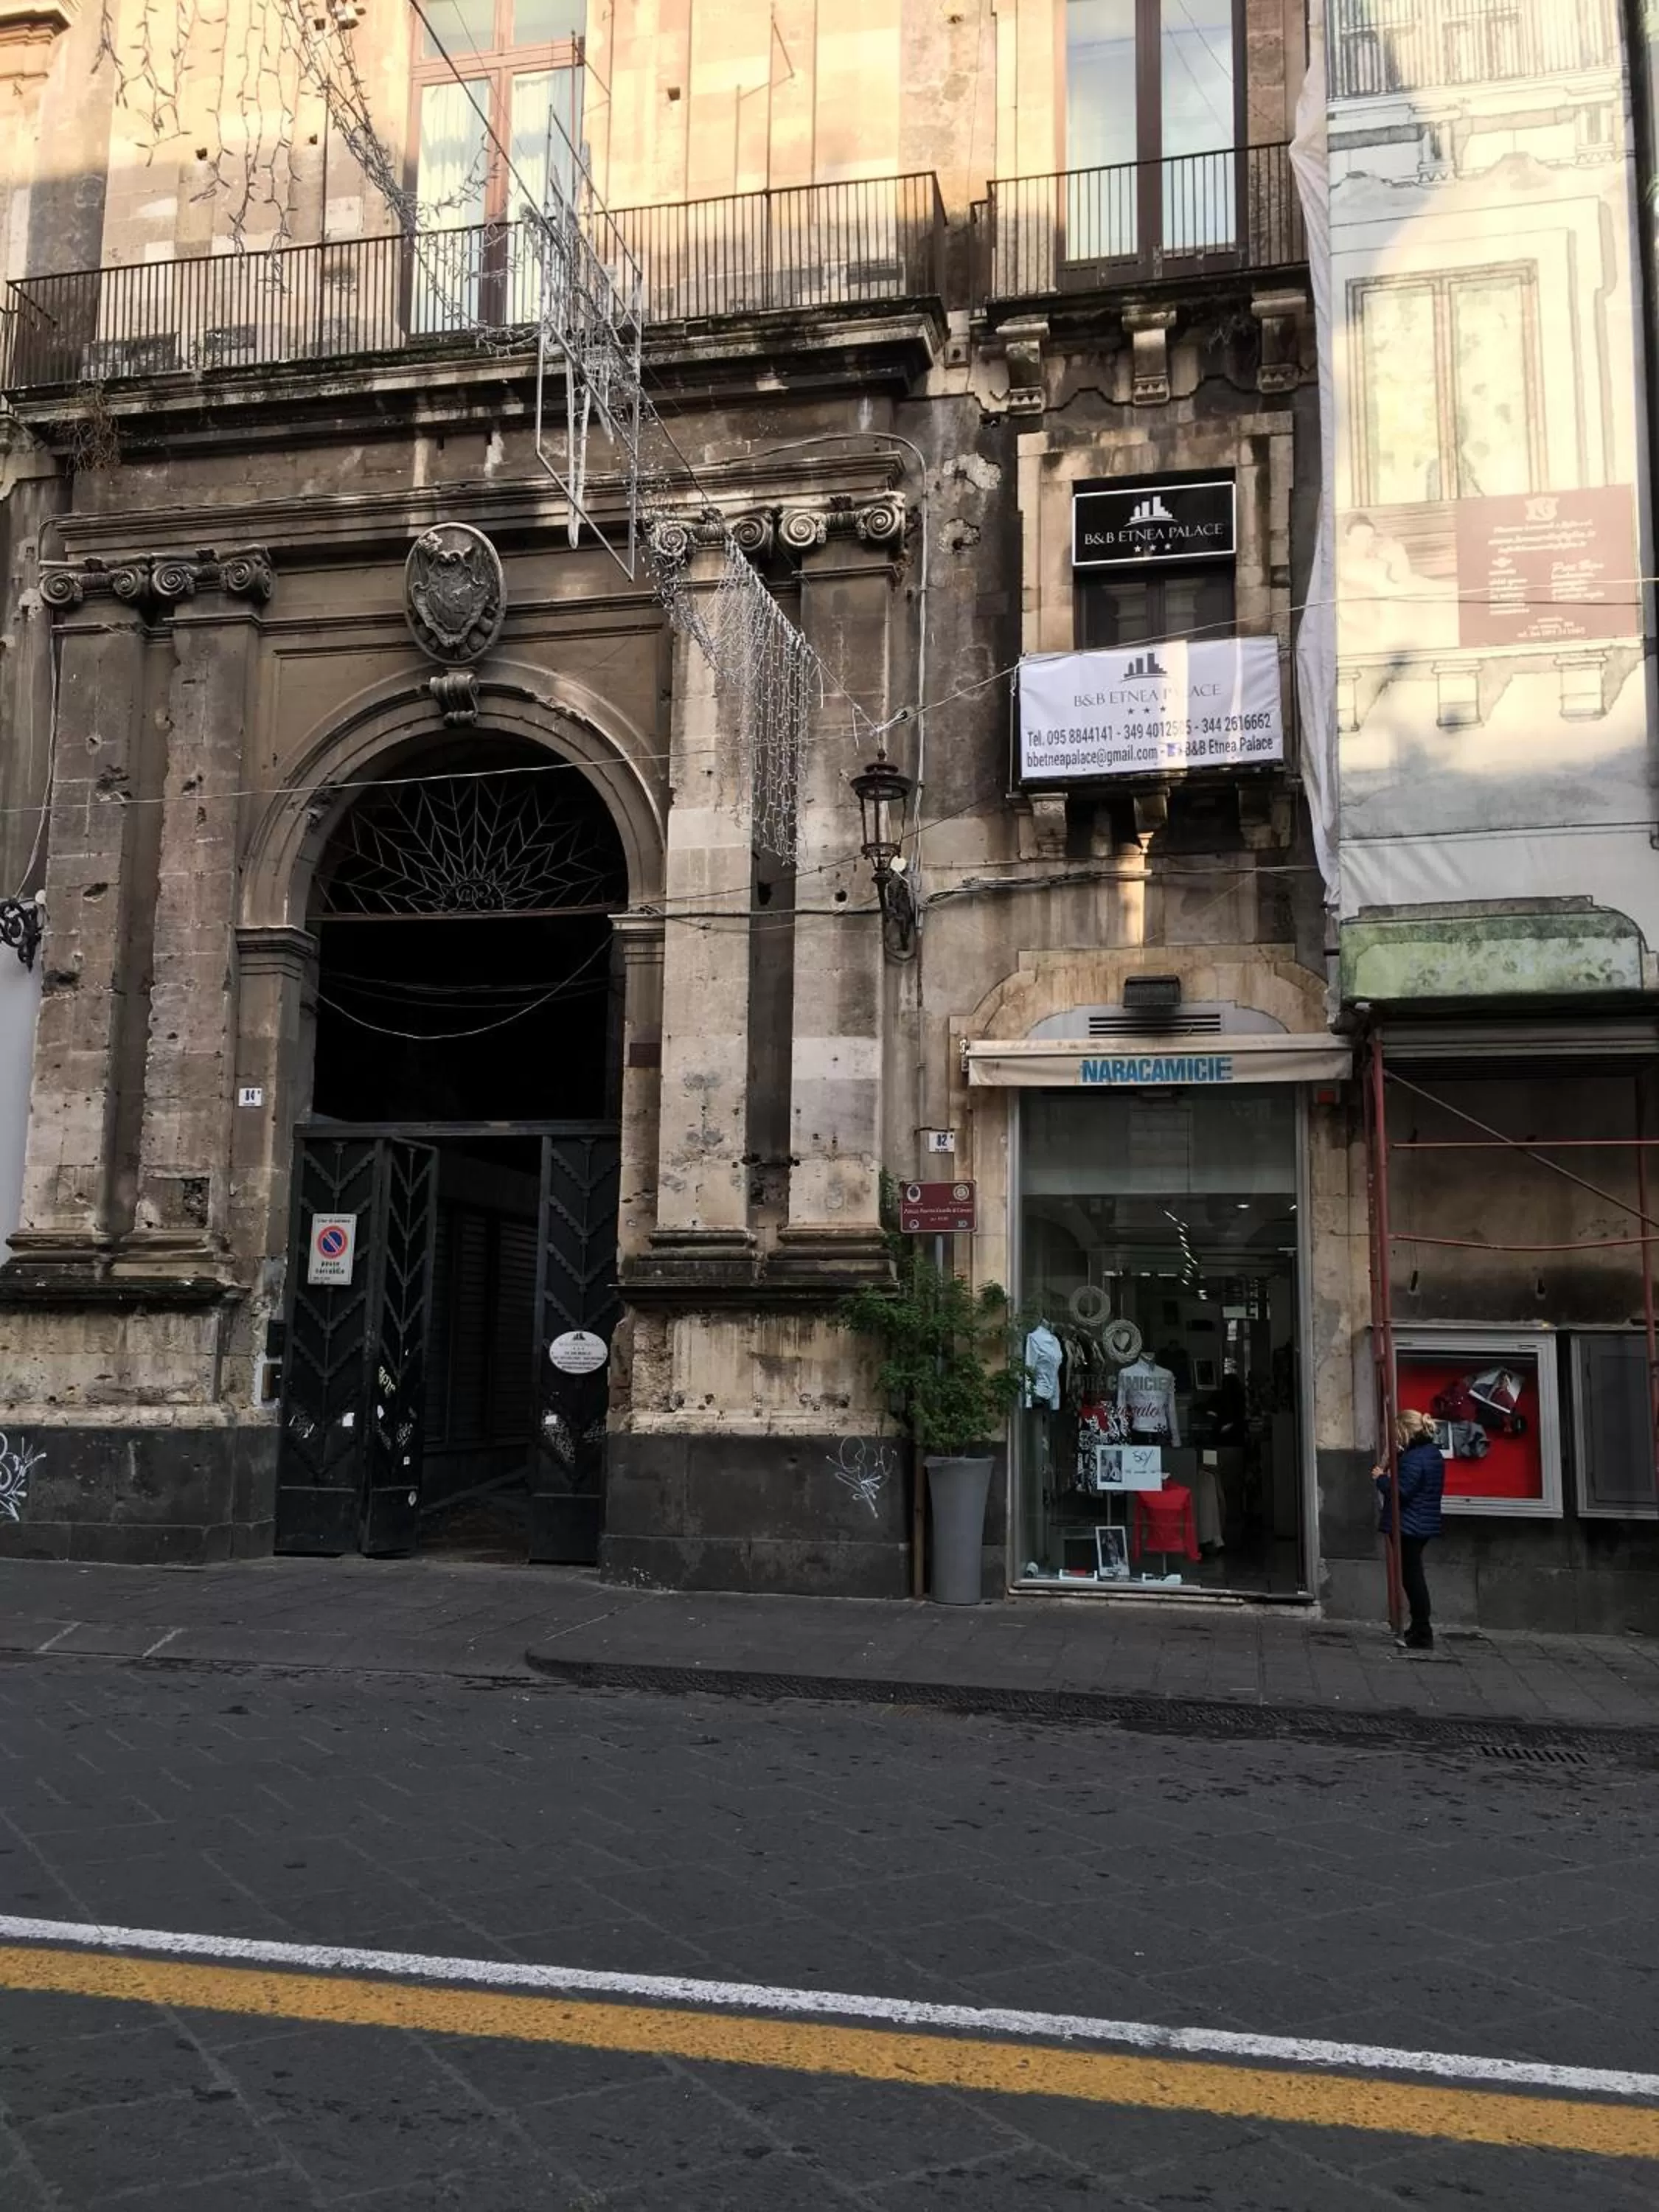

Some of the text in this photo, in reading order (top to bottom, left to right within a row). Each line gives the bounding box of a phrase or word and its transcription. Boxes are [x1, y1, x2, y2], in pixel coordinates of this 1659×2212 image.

[1085, 523, 1224, 545] B&B ETNEA PALACE
[1074, 684, 1222, 707] B&B ETNEA PACE
[1027, 731, 1045, 747] Tel.
[1046, 729, 1066, 745] 095
[1068, 725, 1113, 744] 8844141
[1124, 723, 1143, 740] 349
[1146, 719, 1192, 738] 401255
[1201, 716, 1222, 734] 344
[1225, 713, 1271, 733] 2616662
[1026, 745, 1158, 769] bbetneapalace@gmail.com
[1186, 739, 1206, 757] B&B
[1208, 738, 1237, 754] Etnea
[1239, 734, 1273, 752] Palace
[1082, 1057, 1233, 1082] NARACAMICIE
